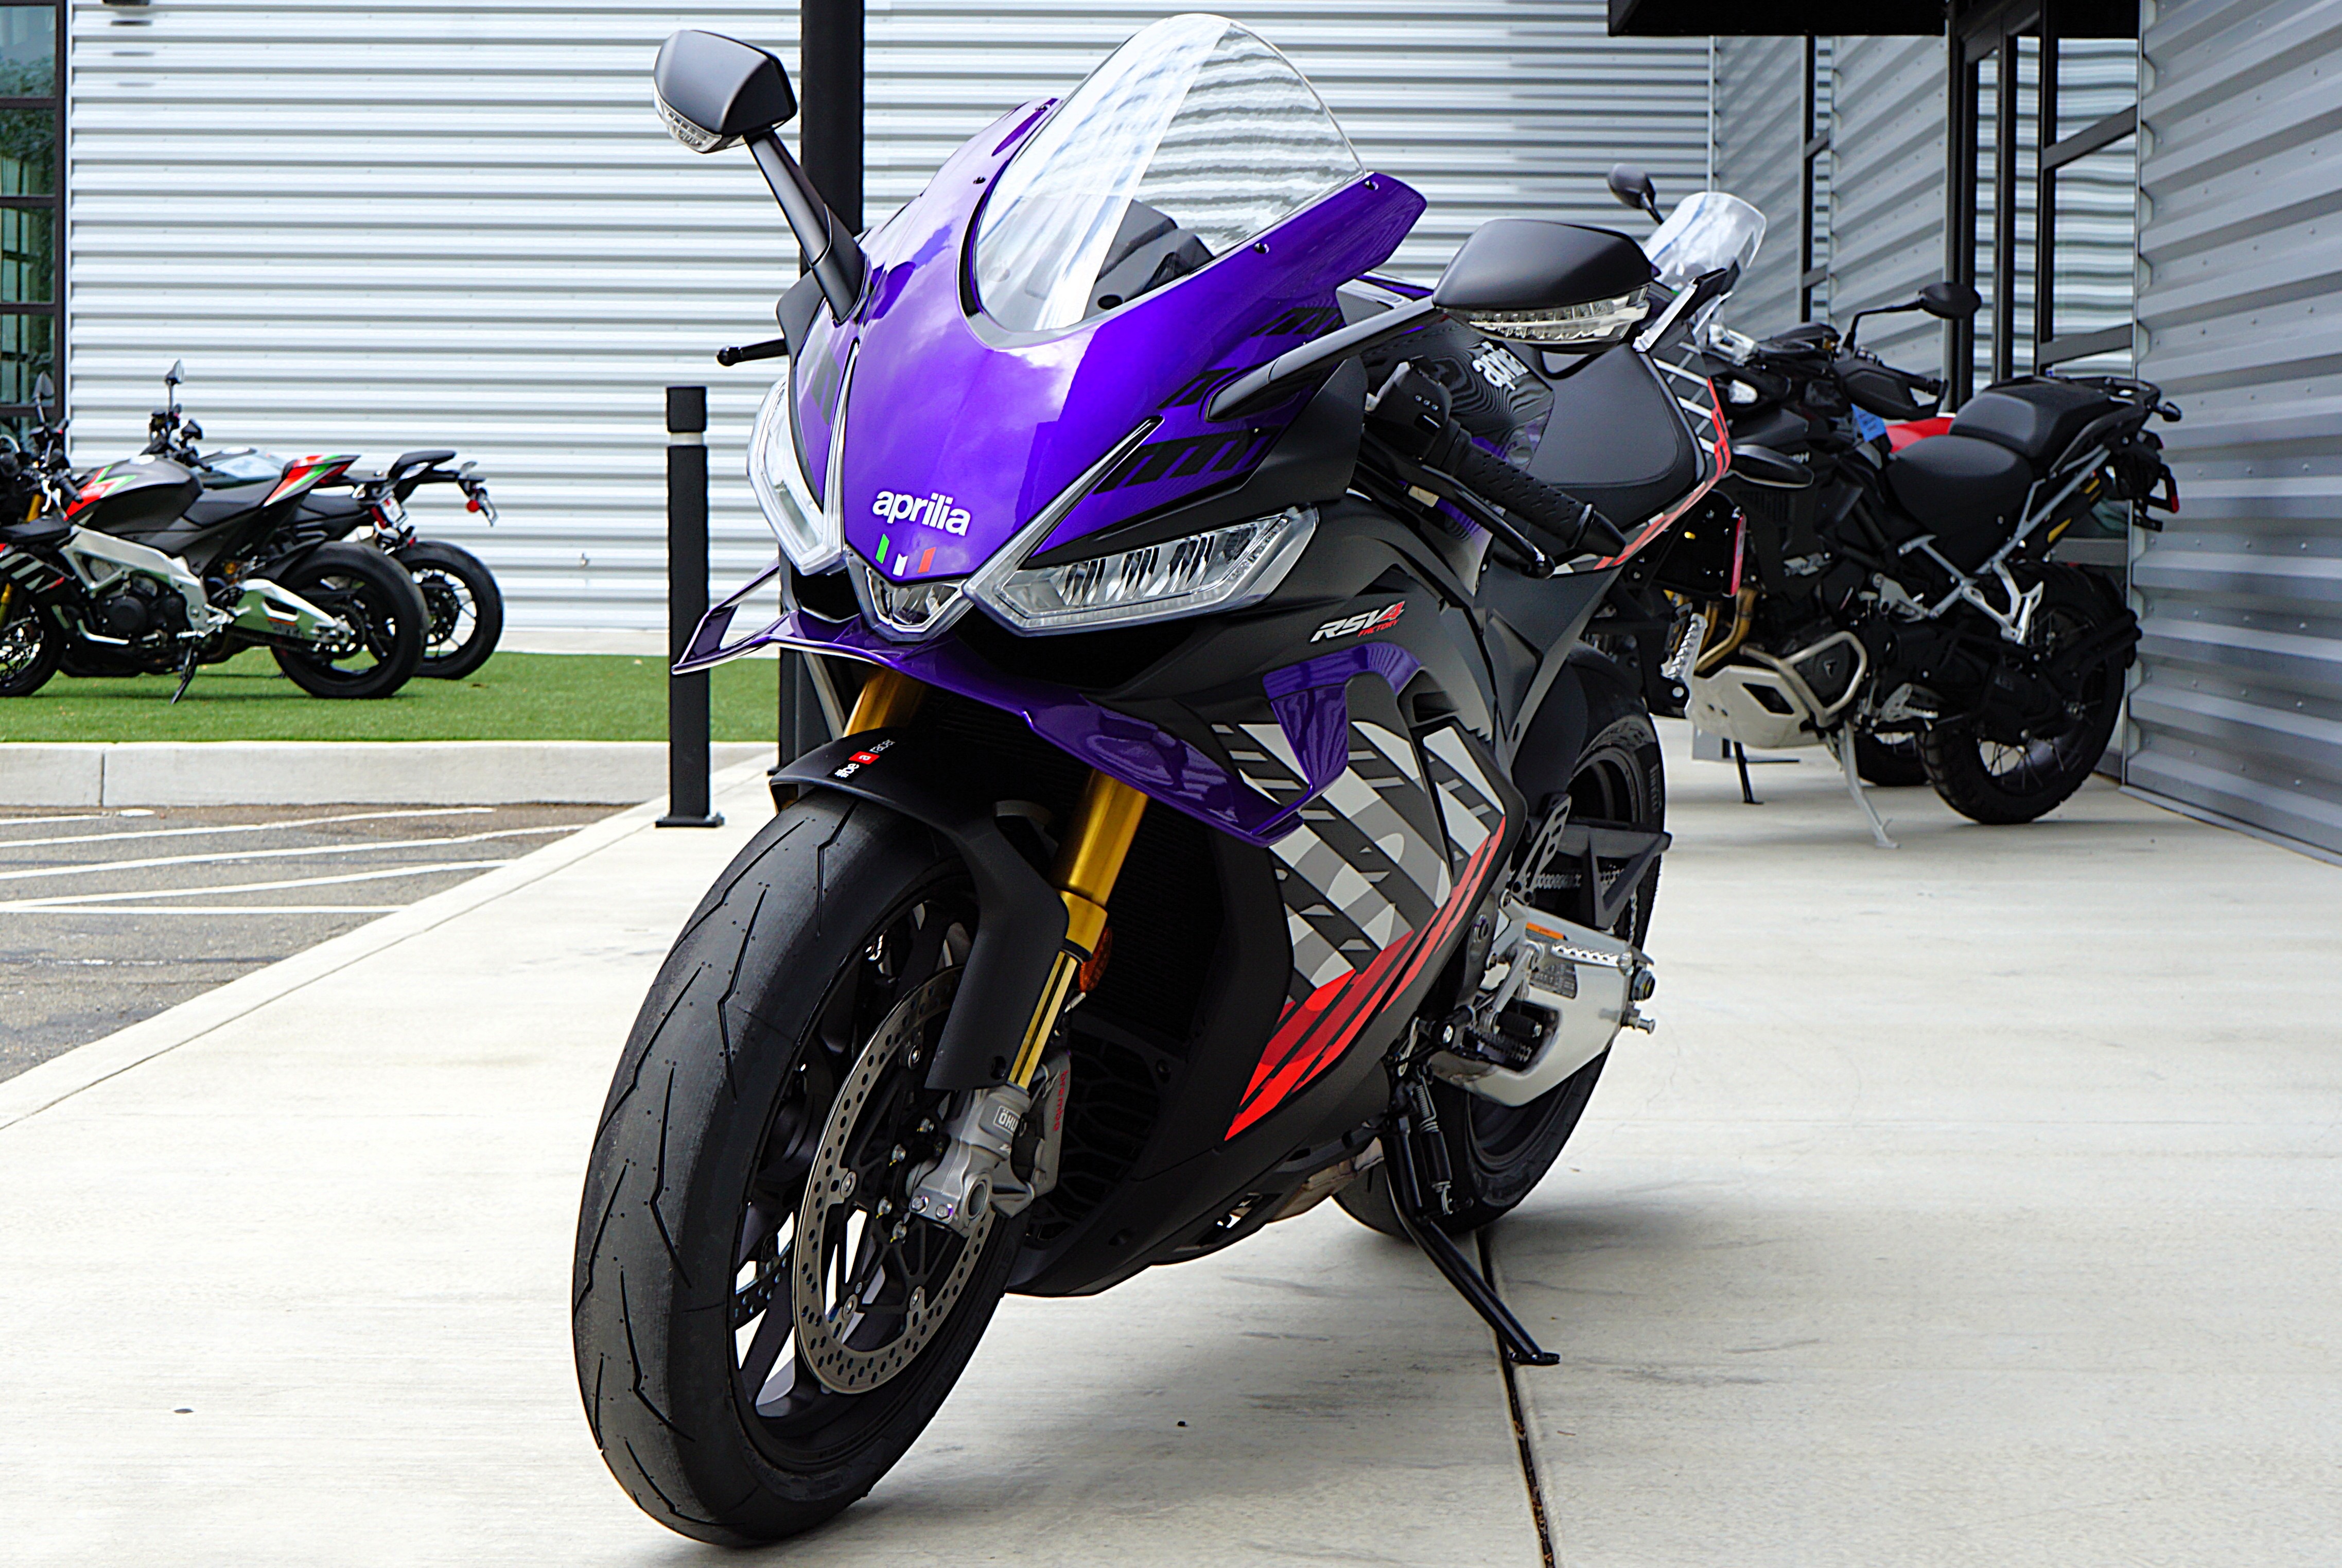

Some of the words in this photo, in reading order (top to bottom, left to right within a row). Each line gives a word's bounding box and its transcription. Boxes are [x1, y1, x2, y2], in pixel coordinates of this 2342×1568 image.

[872, 491, 971, 536] aprilia
[1310, 600, 1405, 643] RSV4
[1357, 618, 1400, 638] FACTORY
[834, 763, 860, 778] #be
[1054, 1070, 1069, 1131] brembo
